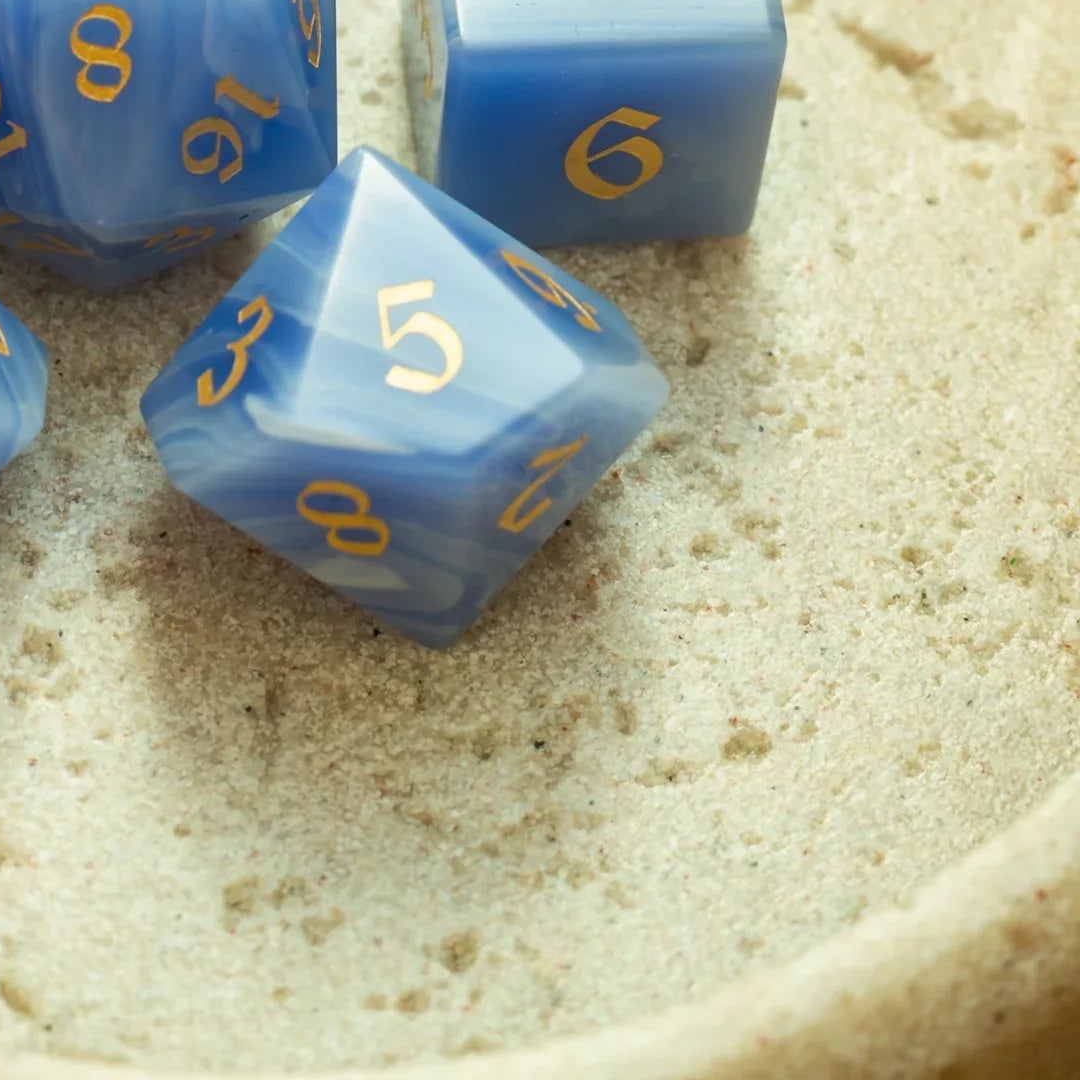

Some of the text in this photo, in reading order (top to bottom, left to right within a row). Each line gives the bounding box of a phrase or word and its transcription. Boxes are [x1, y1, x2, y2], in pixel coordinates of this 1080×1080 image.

[69, 4, 133, 103] 8
[564, 106, 664, 200] 6
[196, 294, 274, 407] 3
[377, 279, 463, 395] 5
[296, 480, 390, 556] 8
[497, 434, 590, 533] 2
